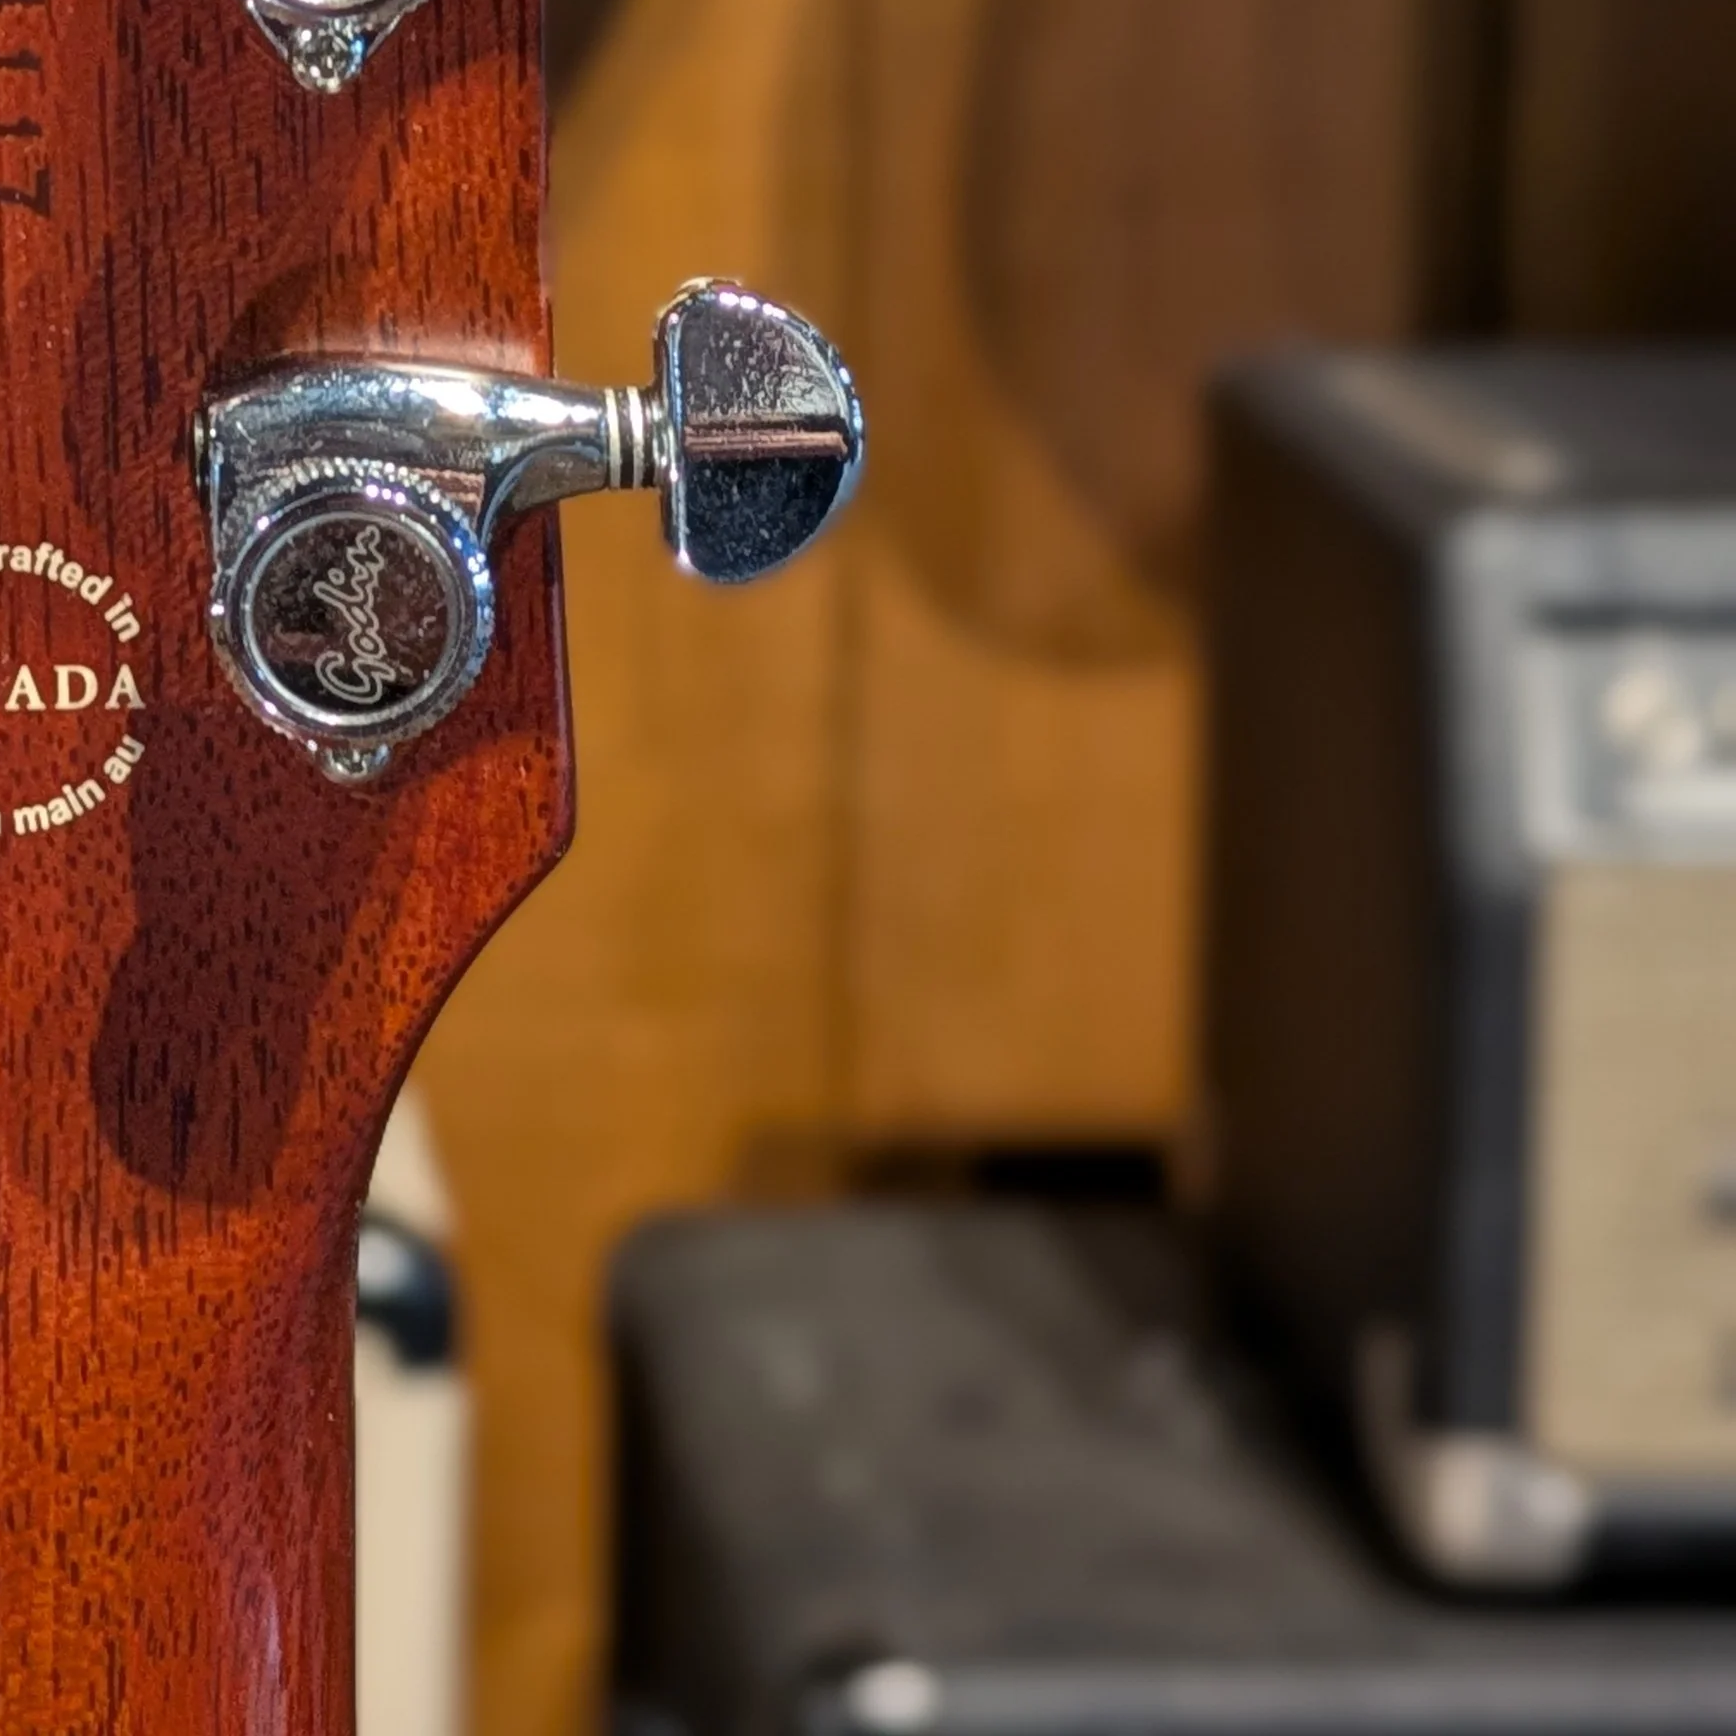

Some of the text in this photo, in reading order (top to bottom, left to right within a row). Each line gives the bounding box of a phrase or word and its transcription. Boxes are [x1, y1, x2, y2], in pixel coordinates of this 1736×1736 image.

[104, 592, 141, 644] in
[312, 524, 397, 704] Godin
[12, 778, 106, 836] main
[103, 733, 146, 785] au
